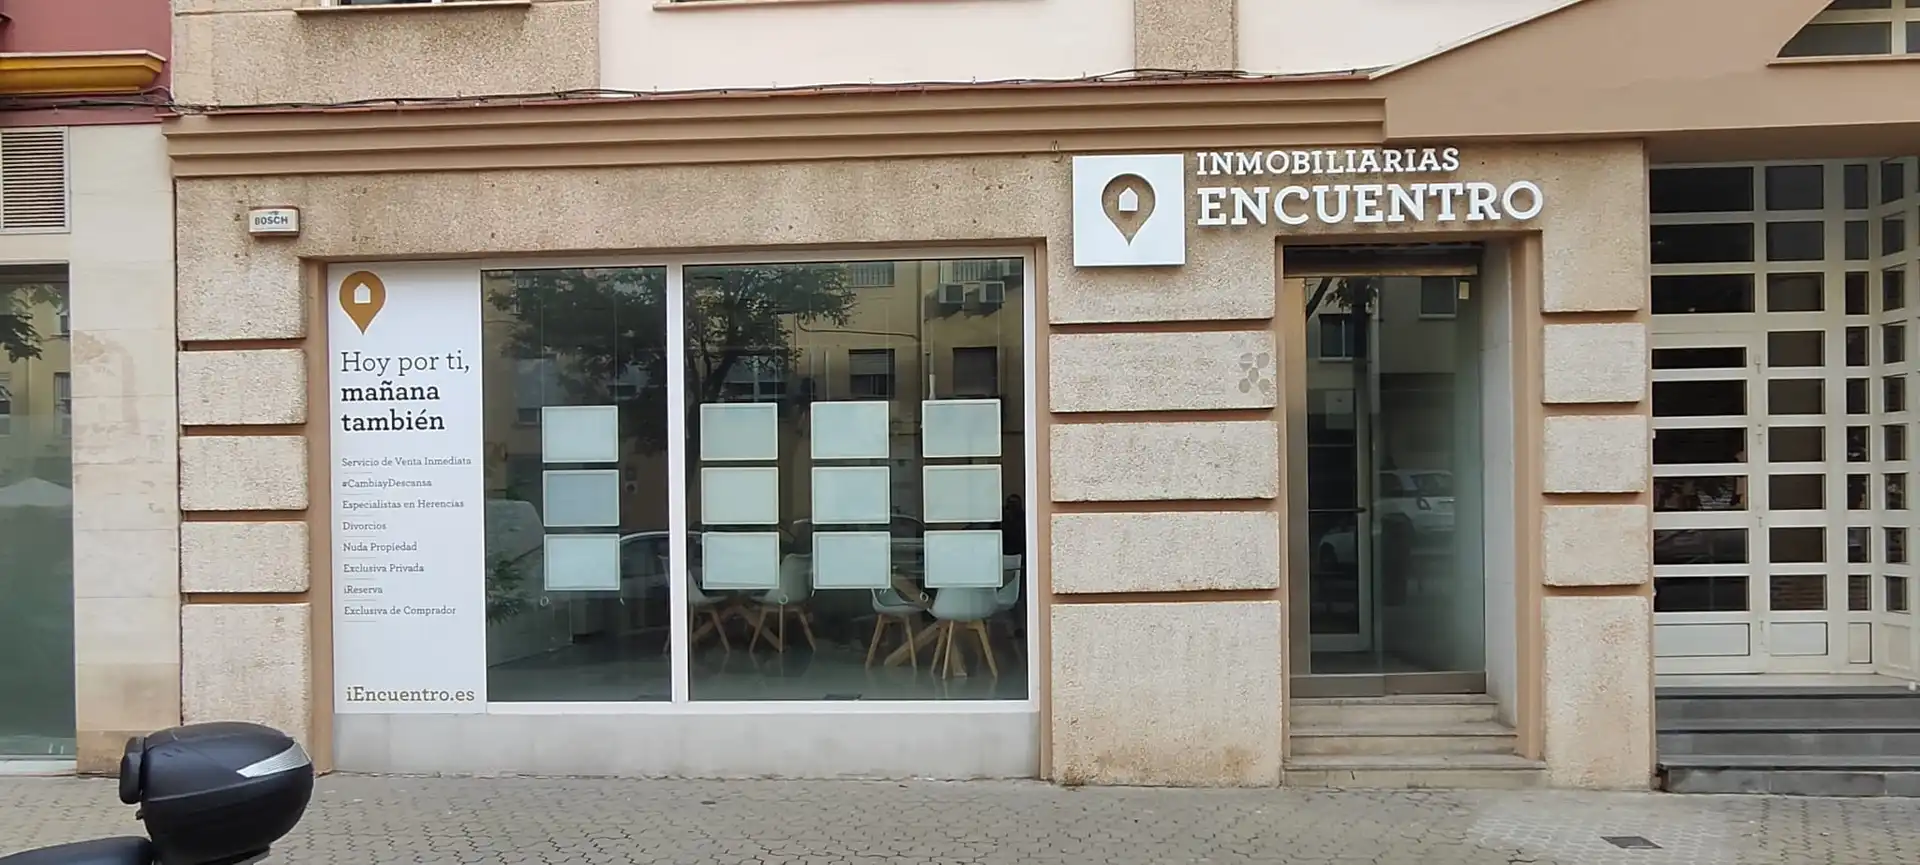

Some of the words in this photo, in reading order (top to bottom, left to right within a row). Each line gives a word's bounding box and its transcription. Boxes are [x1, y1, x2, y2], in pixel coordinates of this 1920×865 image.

[1196, 147, 1460, 176] INMOBILIARIAS
[1197, 180, 1544, 226] ENCUENTRO
[254, 216, 288, 225] BOSCH
[341, 351, 391, 377] Hoy
[398, 355, 440, 376] por
[446, 350, 470, 374] ti,
[341, 380, 440, 402] mañana
[341, 408, 445, 432] también
[342, 457, 380, 467] Servicio
[381, 456, 393, 466] de
[395, 456, 422, 466] Venta
[424, 456, 472, 466] Inmediata
[342, 478, 432, 490] #CambiayDescansa
[342, 500, 402, 511] Especialistas
[403, 502, 416, 510] en
[417, 499, 465, 510] Herencias
[342, 521, 387, 531] Divorcios
[343, 542, 369, 552] Nuda
[370, 541, 417, 553] Propiedad
[343, 563, 388, 573] Exclusiva
[389, 563, 425, 573] Privada
[343, 585, 383, 594] iReserva
[344, 606, 388, 616] Exclusiva
[389, 606, 402, 616] de
[403, 605, 457, 617] Comprador
[346, 686, 475, 702] iEncuentro.es
